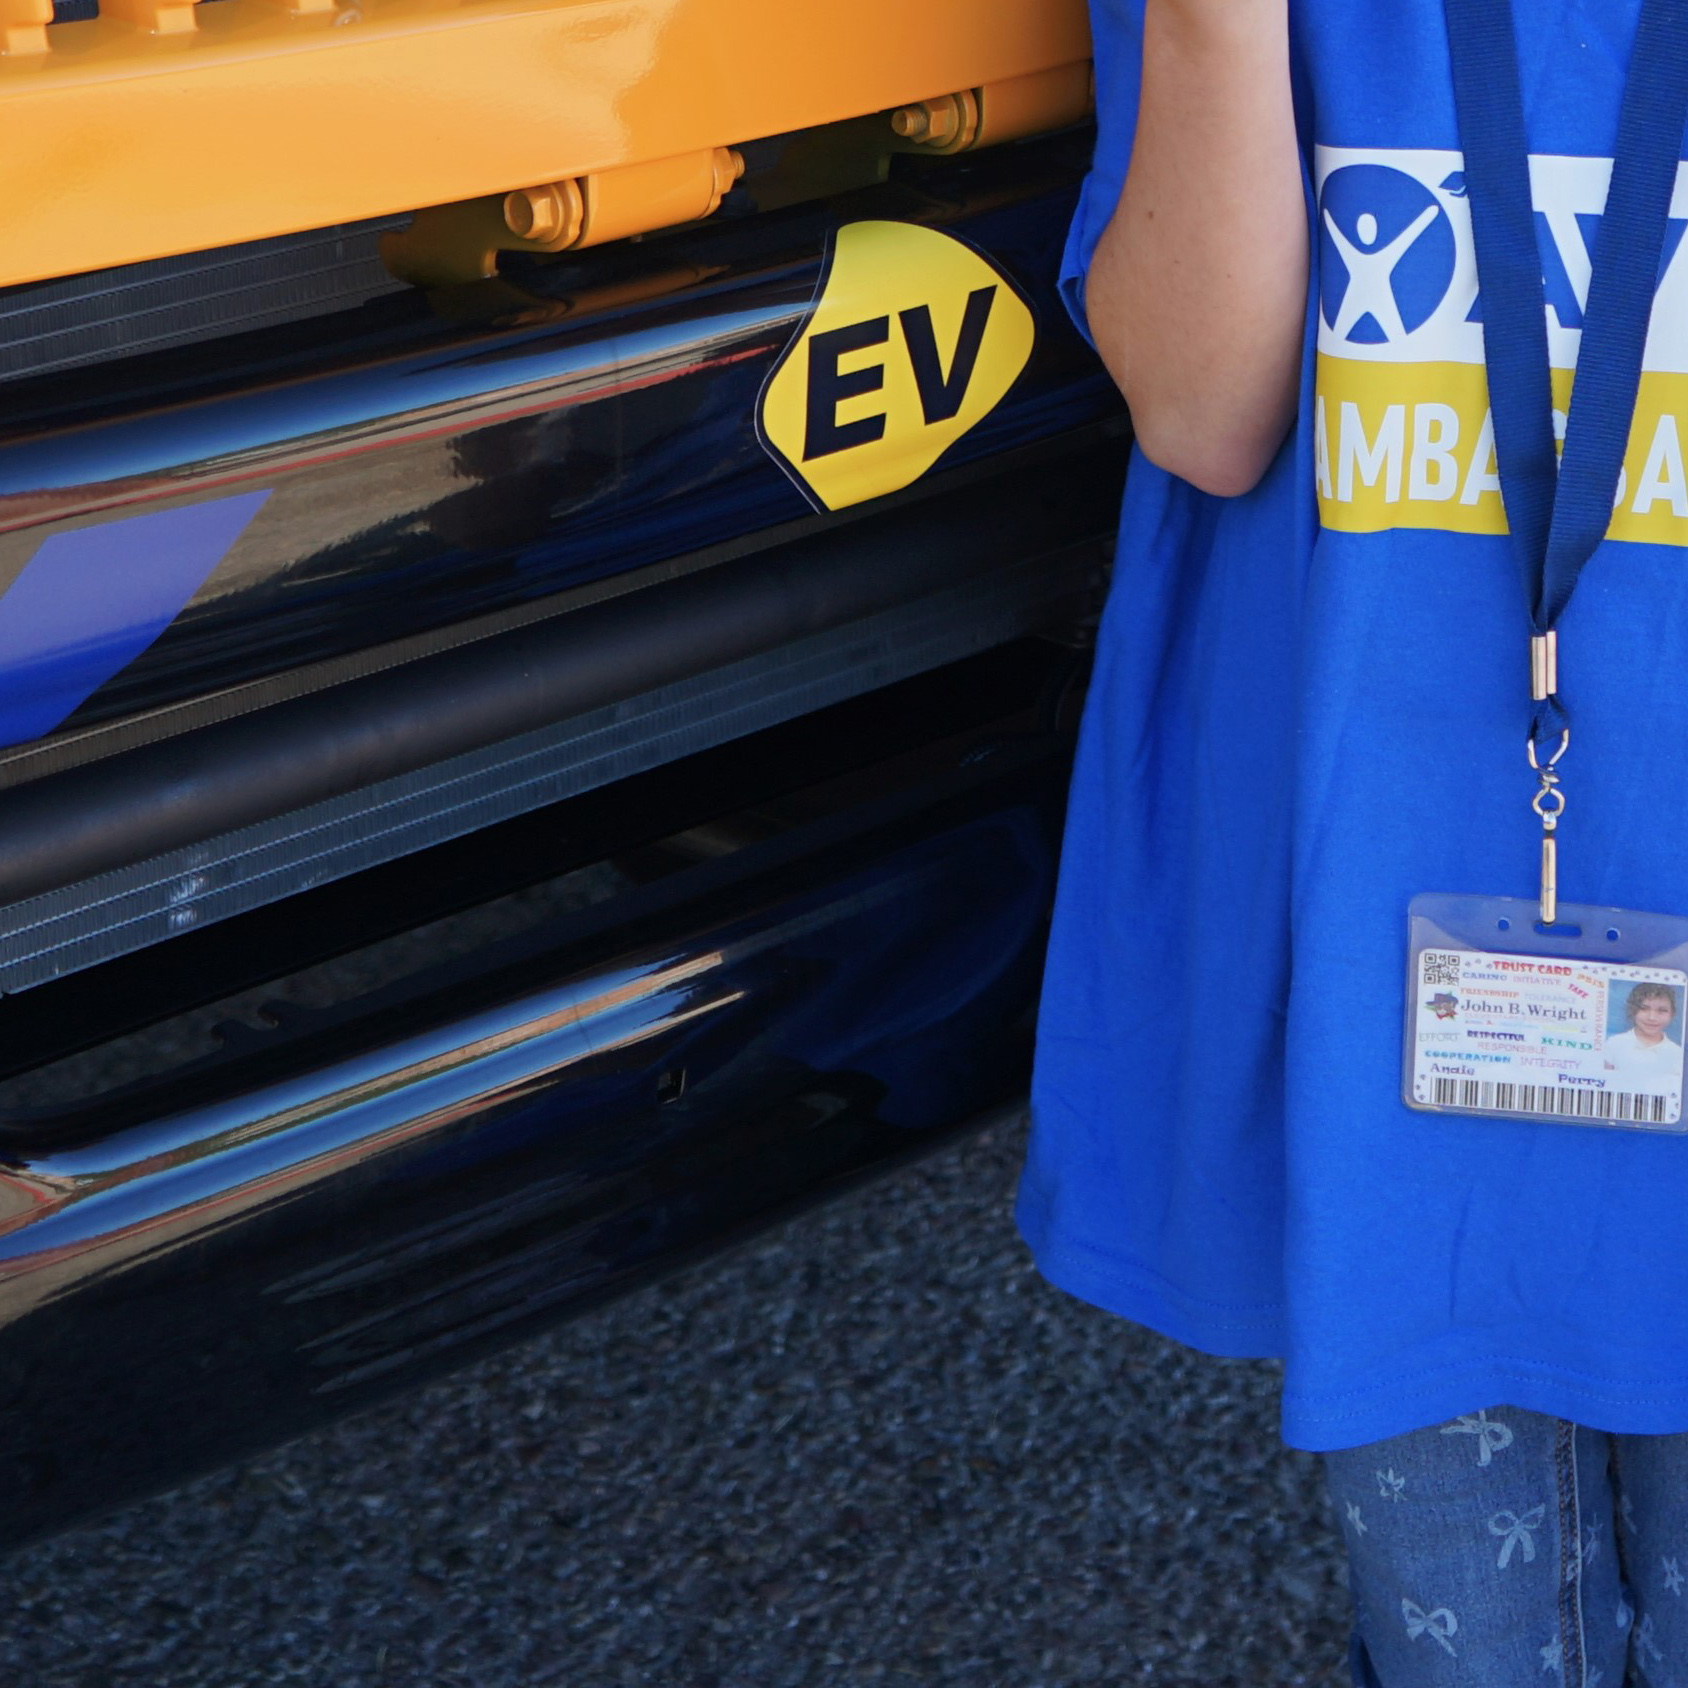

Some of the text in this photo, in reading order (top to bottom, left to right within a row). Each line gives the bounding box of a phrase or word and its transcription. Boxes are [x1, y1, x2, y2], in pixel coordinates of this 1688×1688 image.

[801, 283, 998, 463] EV
[1493, 960, 1572, 977] TRUST CARD
[1460, 999, 1504, 1014] John
[1527, 1004, 1587, 1021] Wright
[1541, 1036, 1593, 1051] KIND
[1424, 1050, 1511, 1063] COOPERATION
